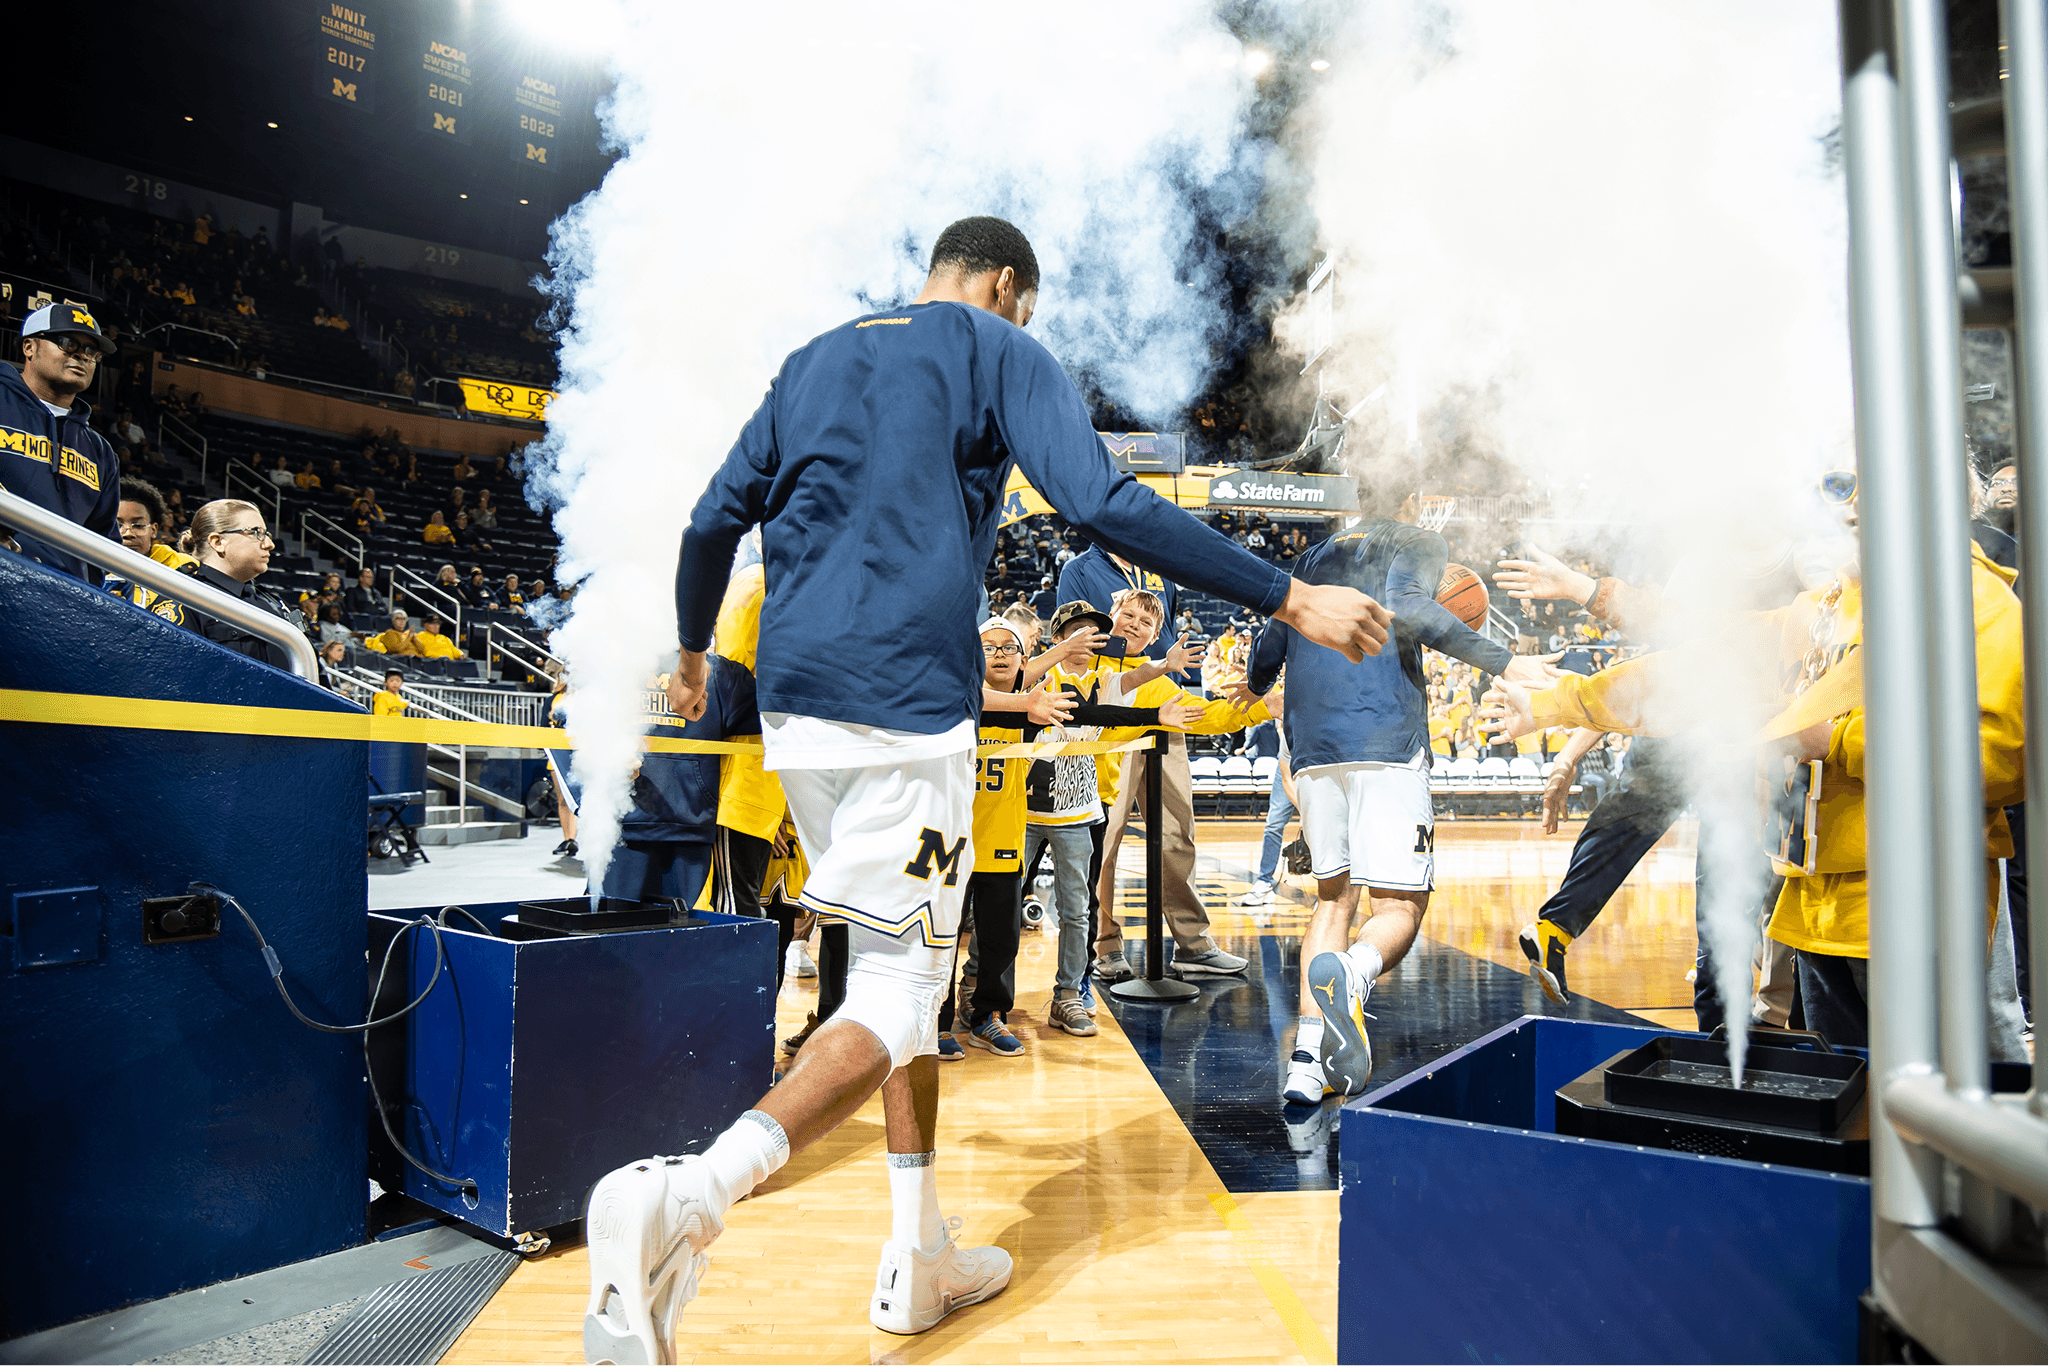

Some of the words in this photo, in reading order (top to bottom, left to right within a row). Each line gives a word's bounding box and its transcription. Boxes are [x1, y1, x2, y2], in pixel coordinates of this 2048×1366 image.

[331, 3, 366, 27] WNIT
[321, 15, 375, 42] CHAMPIONS
[328, 46, 365, 72] 2017
[424, 53, 459, 73] SWEET
[430, 41, 466, 64] NCAA
[332, 77, 357, 102] M
[429, 83, 462, 107] 2021
[522, 76, 556, 97] NCAA
[433, 112, 456, 134] M
[520, 114, 554, 138] 2022
[526, 142, 547, 163] M
[125, 174, 167, 200] 218
[425, 245, 460, 266] 219
[71, 309, 95, 330] M
[28, 437, 97, 483] WOERINES
[902, 826, 968, 888] M
